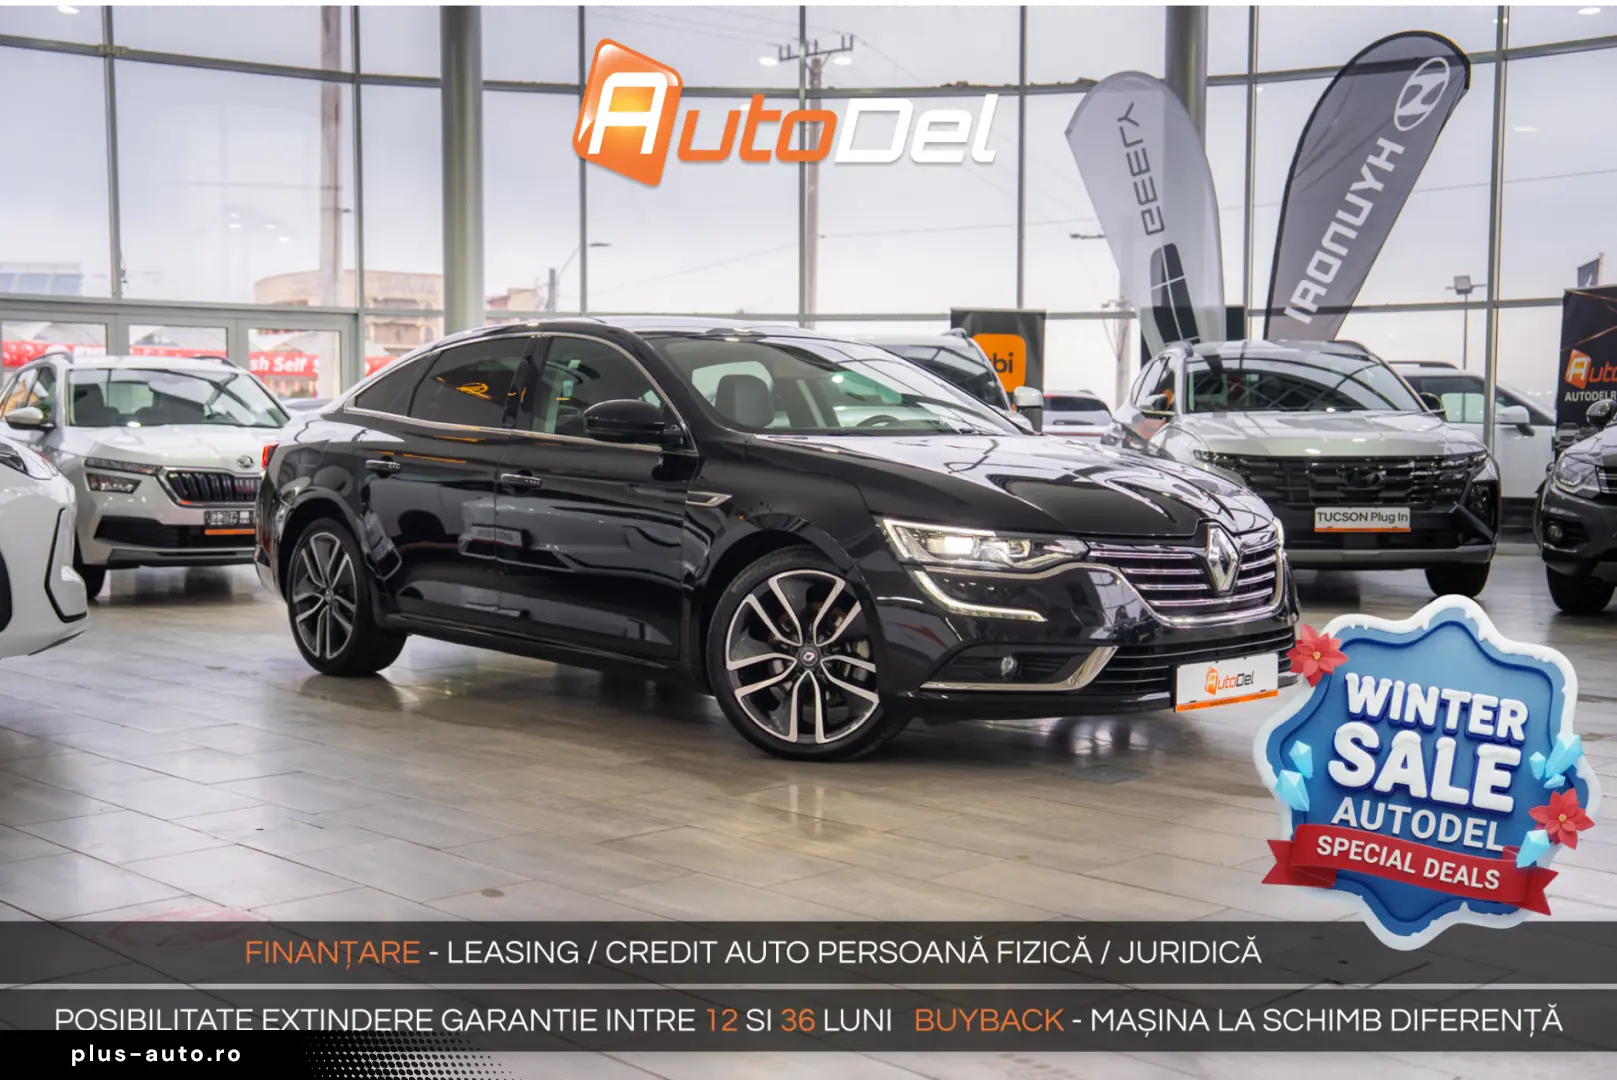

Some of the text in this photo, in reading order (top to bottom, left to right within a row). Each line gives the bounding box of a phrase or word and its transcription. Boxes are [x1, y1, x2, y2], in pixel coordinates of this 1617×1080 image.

[272, 356, 307, 373] Self
[989, 351, 1014, 374] bi
[1317, 511, 1409, 524] TUCSON Plug In
[1205, 669, 1255, 693] AutoDel
